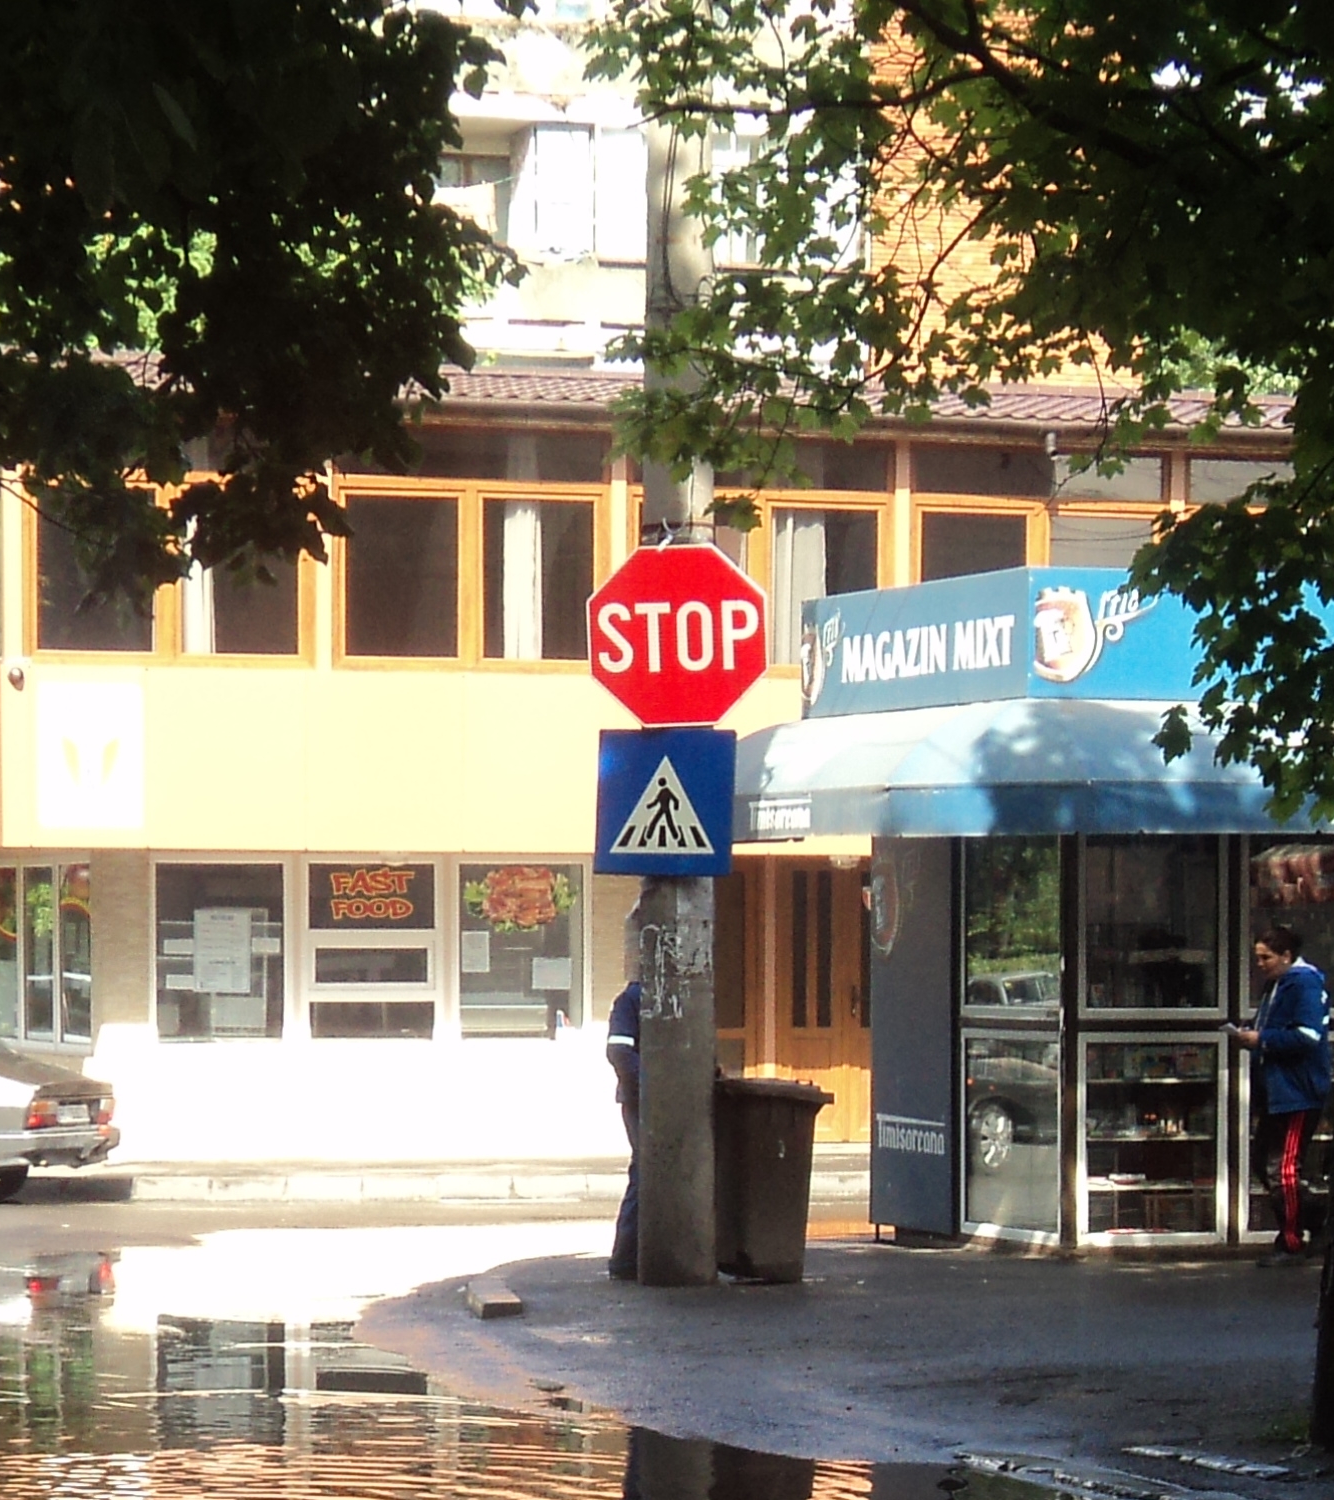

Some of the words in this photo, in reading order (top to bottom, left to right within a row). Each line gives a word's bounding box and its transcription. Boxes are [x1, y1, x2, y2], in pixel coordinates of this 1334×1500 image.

[597, 599, 759, 673] STOP
[841, 624, 947, 684] MAGAZIN
[953, 614, 1015, 671] MIXT
[330, 867, 415, 896] FAST
[330, 898, 414, 920] FOOD
